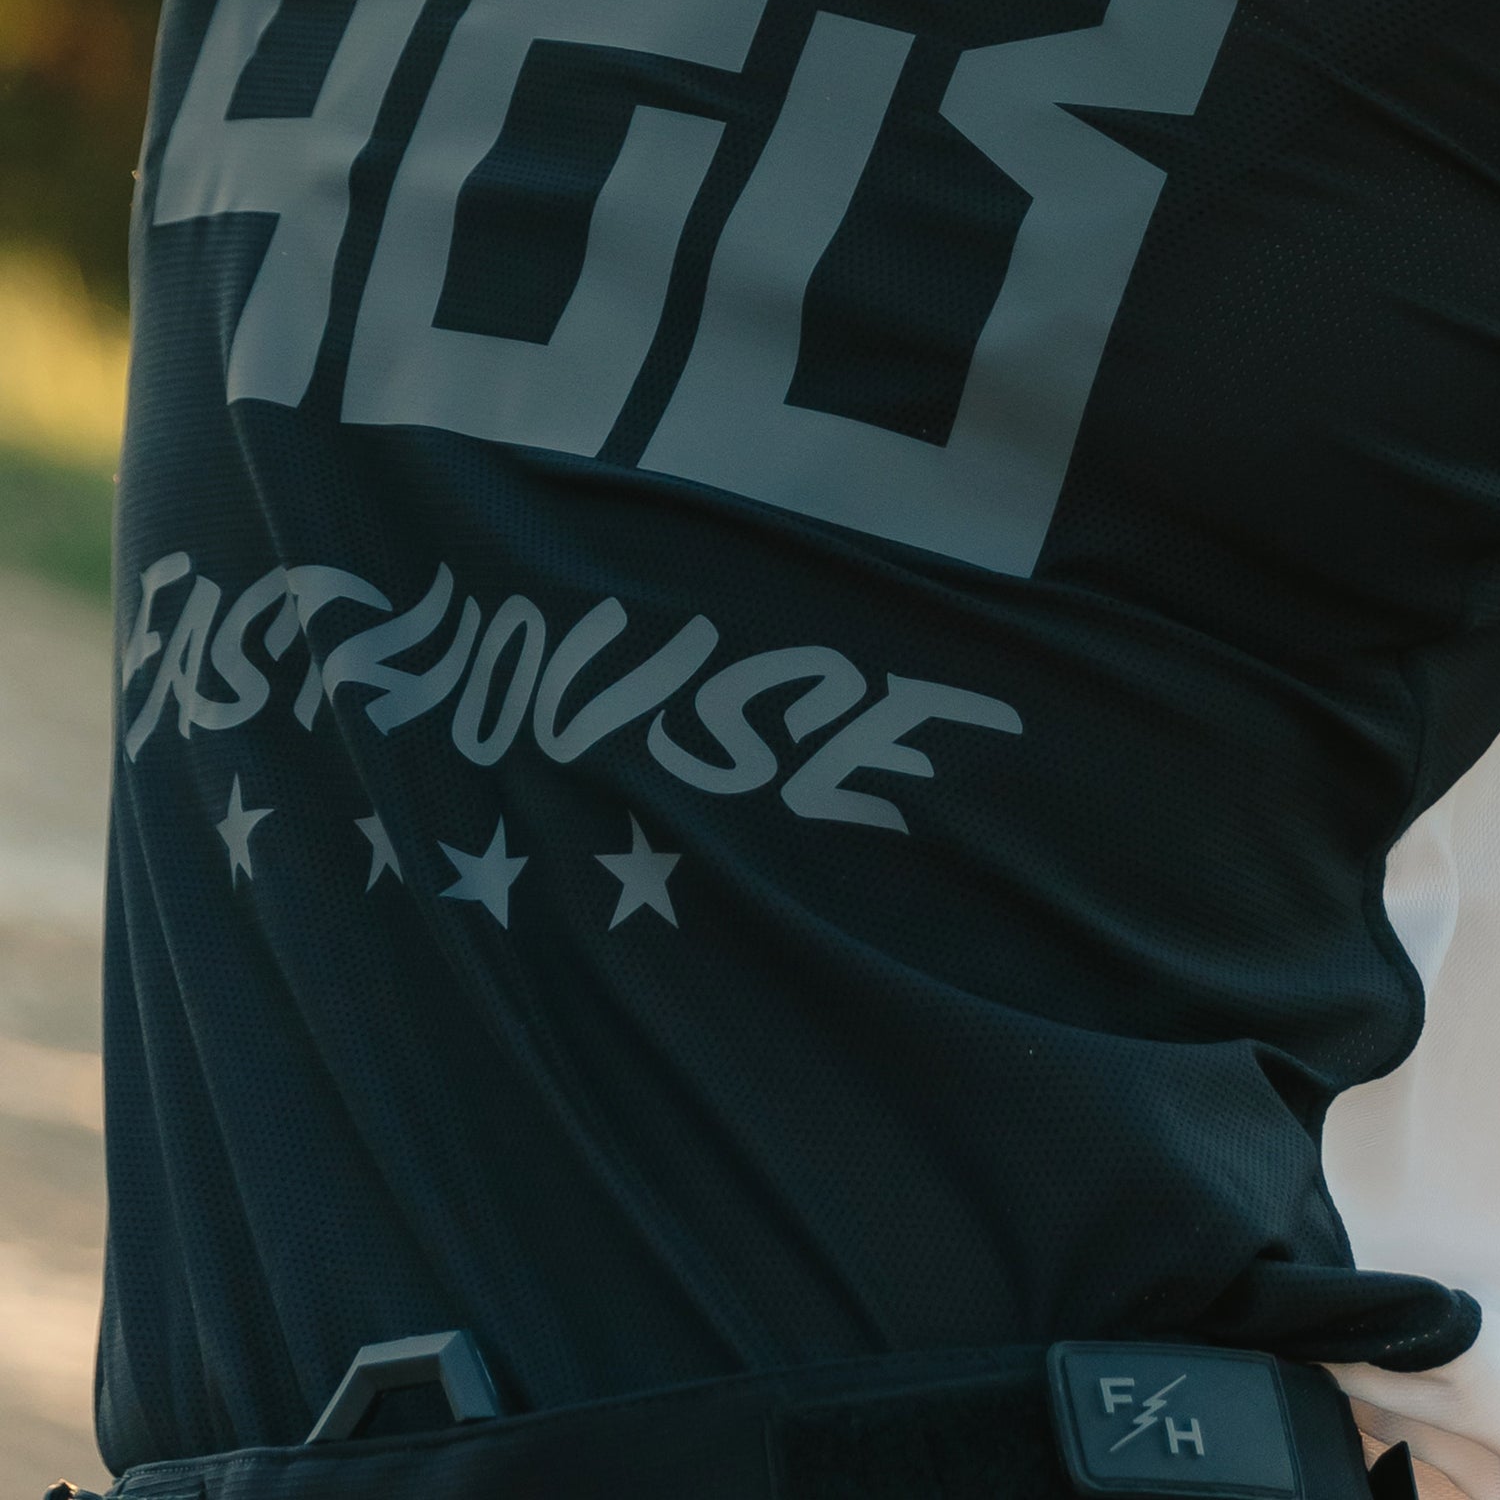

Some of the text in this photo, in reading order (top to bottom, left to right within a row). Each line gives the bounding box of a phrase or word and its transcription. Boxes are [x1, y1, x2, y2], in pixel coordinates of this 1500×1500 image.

[122, 551, 1024, 836] FASTHOUSE
[1099, 1376, 1205, 1456] F H
